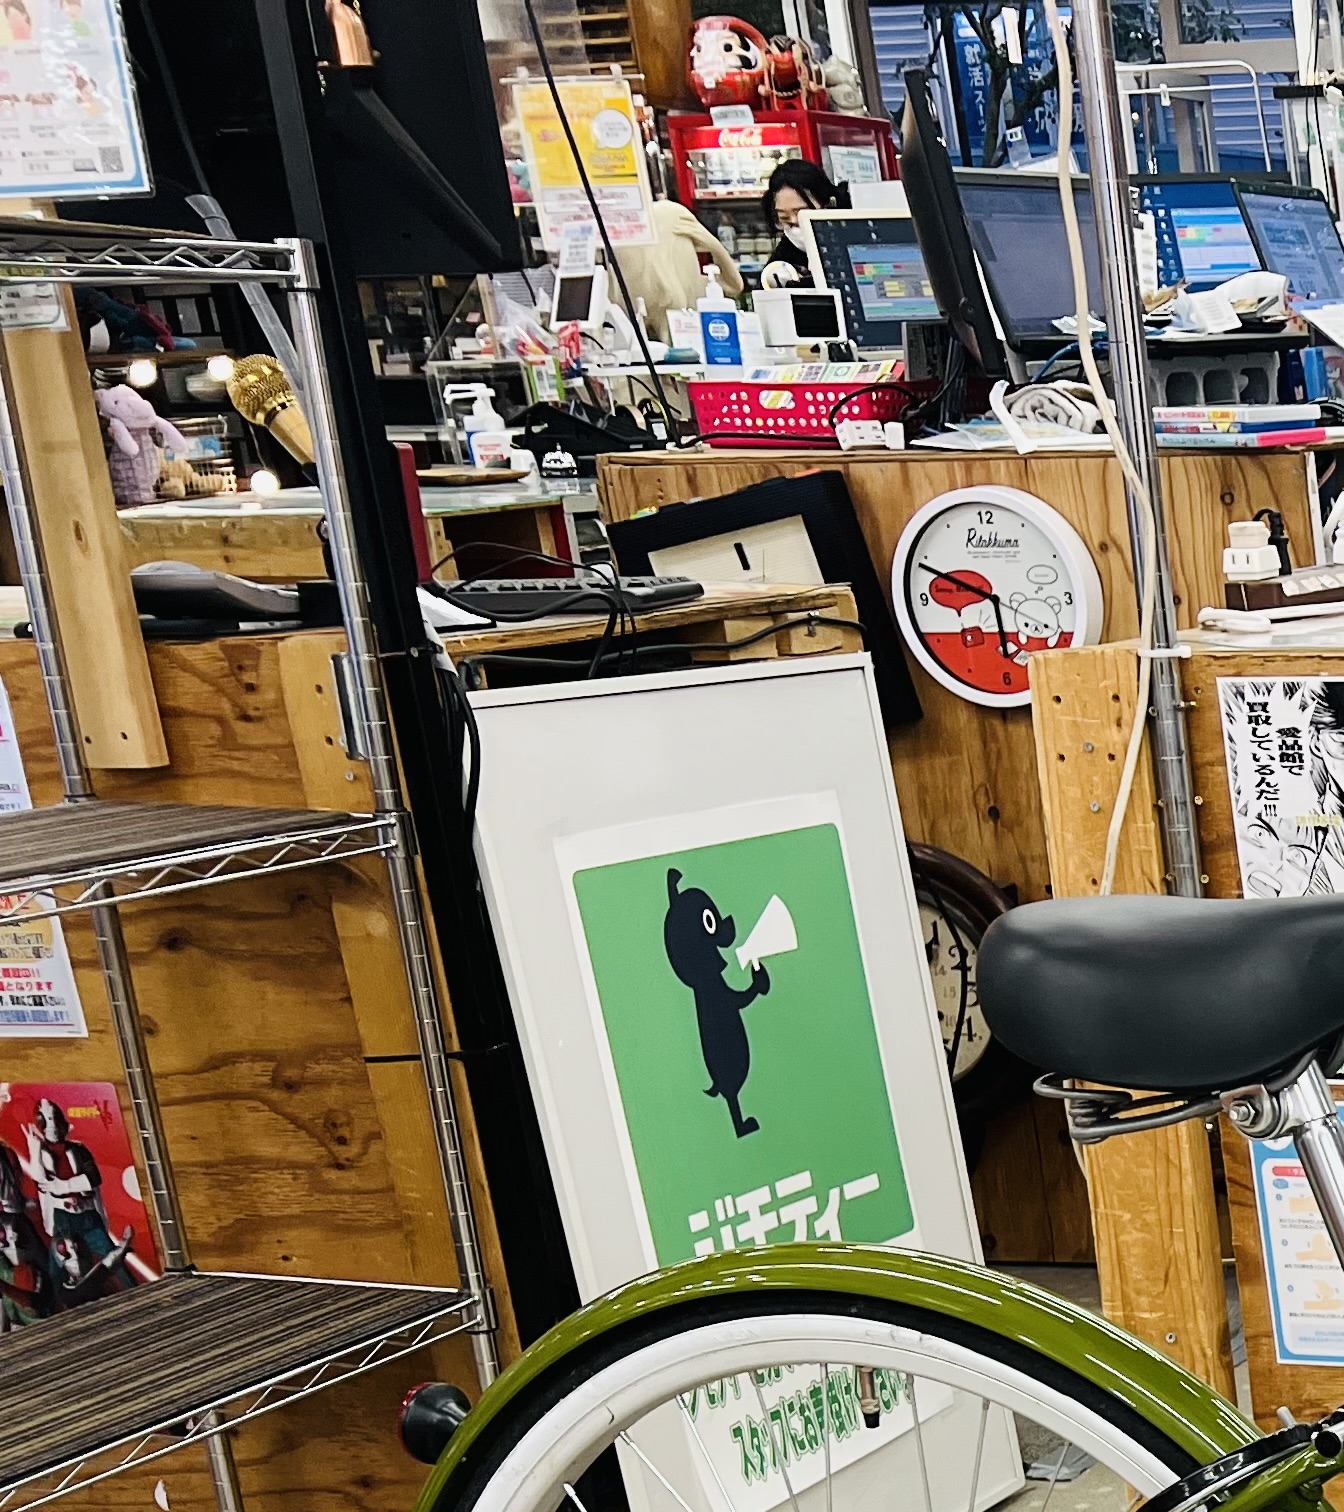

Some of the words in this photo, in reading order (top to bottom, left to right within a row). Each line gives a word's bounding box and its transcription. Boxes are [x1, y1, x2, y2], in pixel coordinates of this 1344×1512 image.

[977, 511, 994, 524] 12
[919, 593, 929, 607] 9
[1063, 591, 1074, 605] 3
[1002, 672, 1012, 686] 6
[688, 1169, 880, 1258] ジモティー
